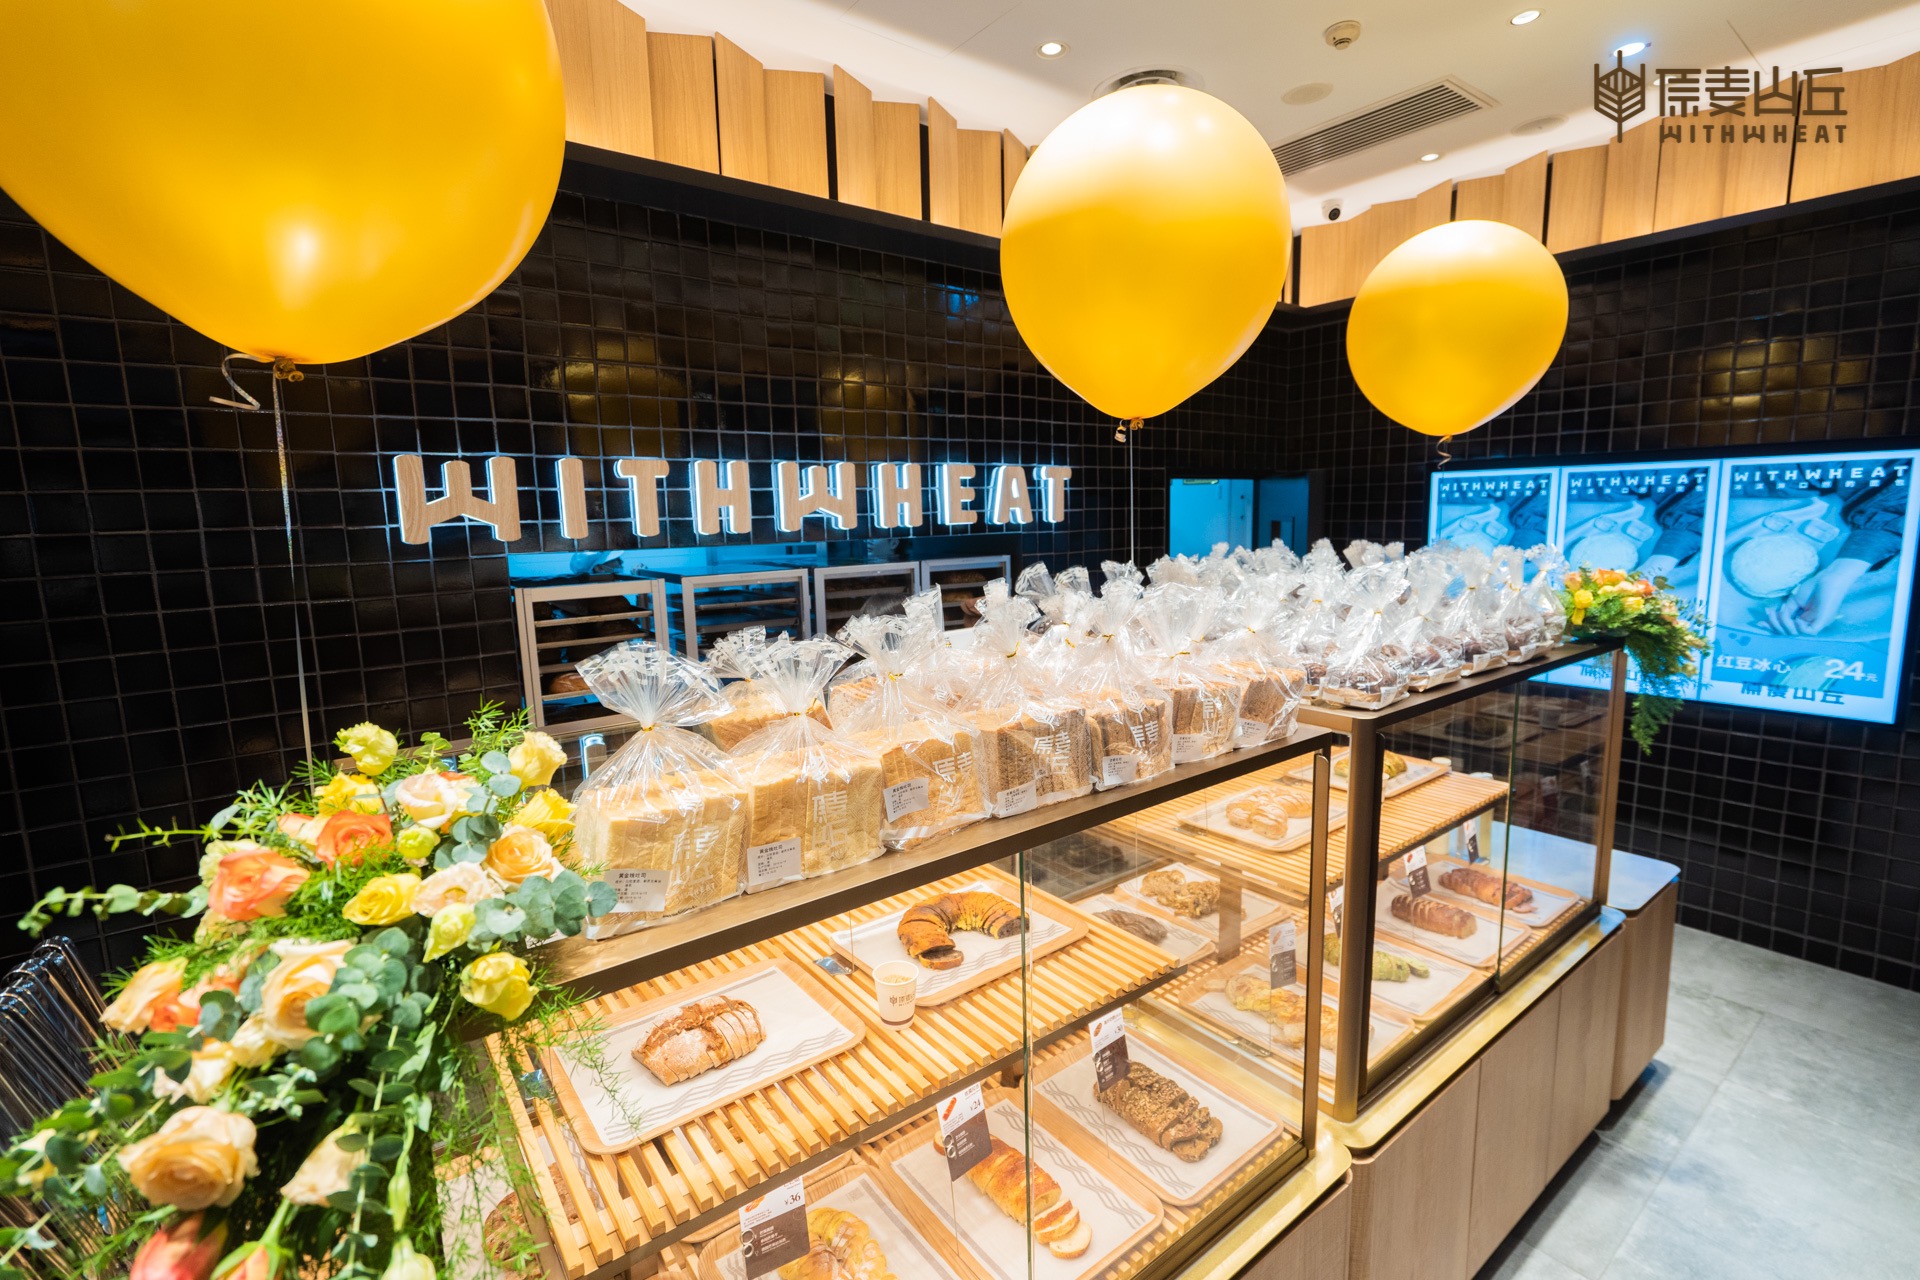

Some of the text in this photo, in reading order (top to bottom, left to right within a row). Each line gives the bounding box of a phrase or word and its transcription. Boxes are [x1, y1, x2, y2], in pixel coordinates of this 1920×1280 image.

[1571, 473, 1707, 488] WITHWHEAT
[1733, 465, 1909, 482] WITHWHEAT
[1440, 479, 1549, 491] WITHWHEAT
[392, 453, 1073, 545] WITHWHEAT
[1716, 654, 1791, 674] 红豆冰心
[784, 1191, 801, 1206] ¥36
